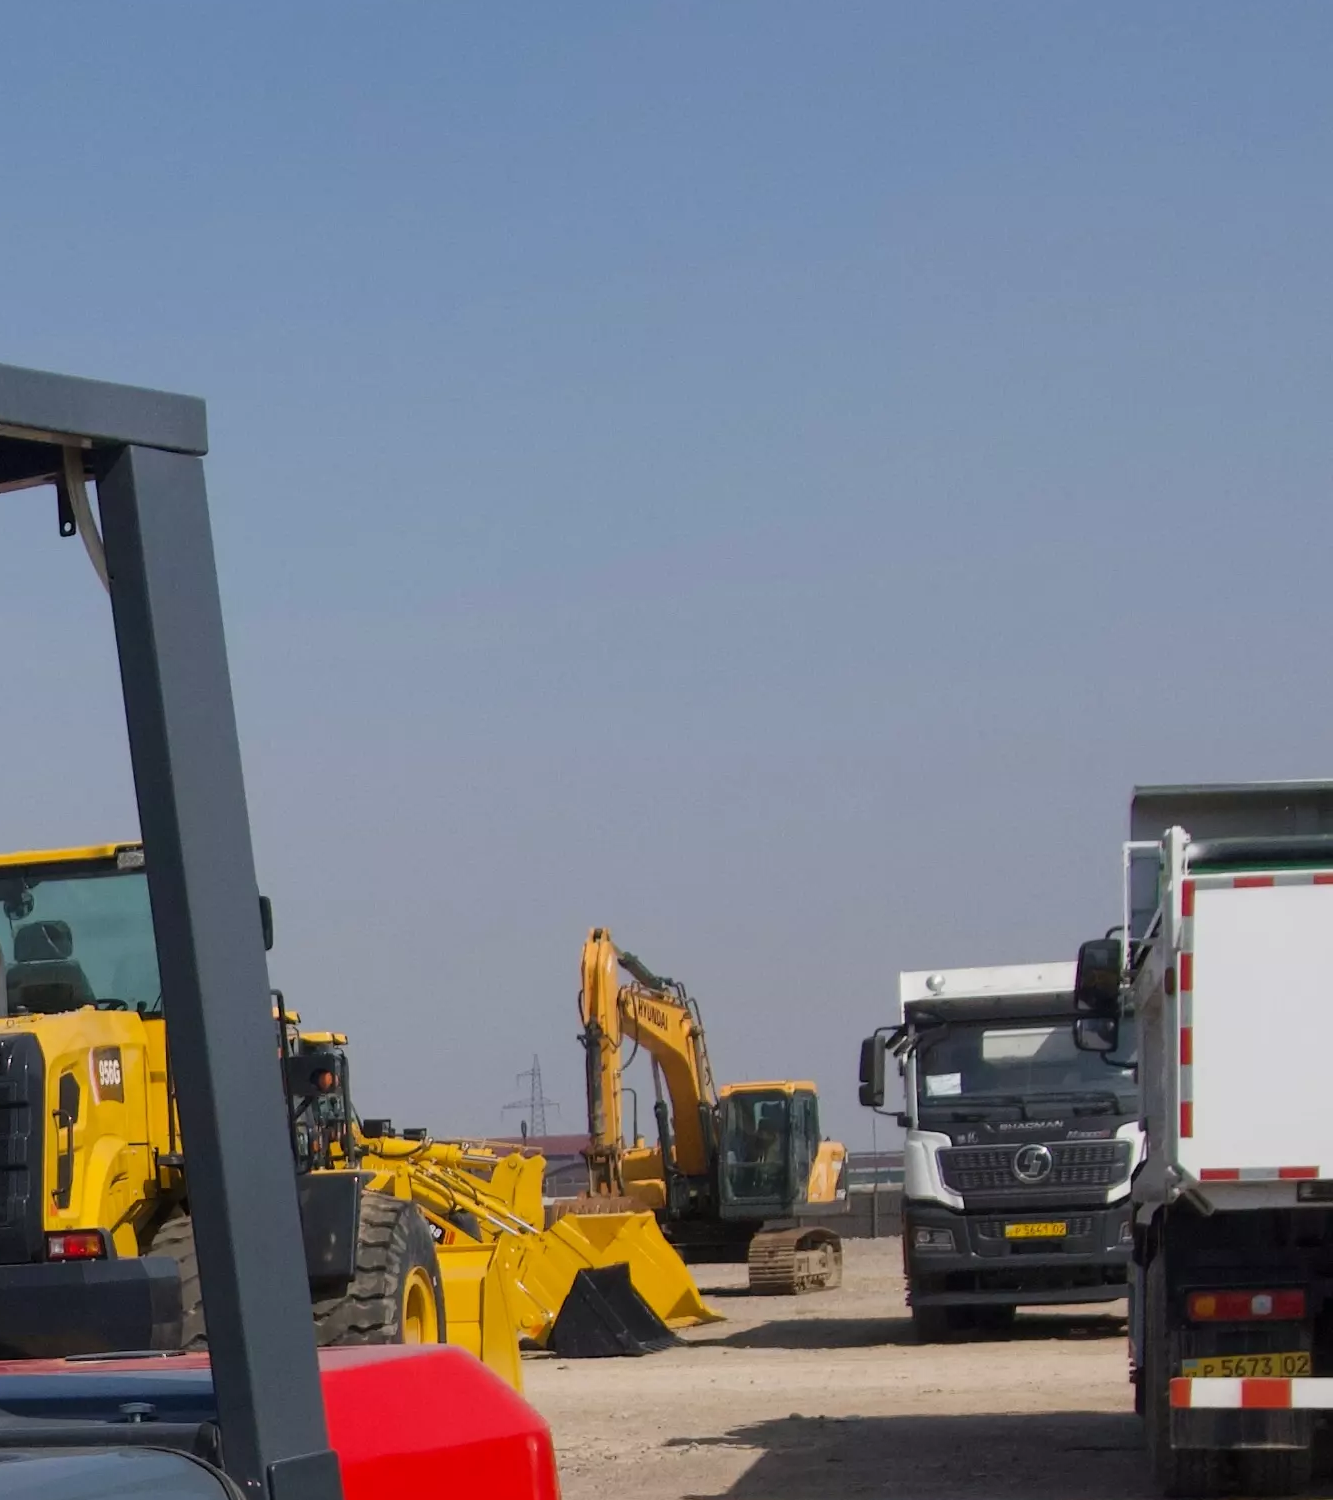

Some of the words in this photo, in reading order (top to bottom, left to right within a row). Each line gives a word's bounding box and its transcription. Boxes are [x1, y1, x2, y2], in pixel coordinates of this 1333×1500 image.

[637, 999, 668, 1031] HYUNDAI
[99, 1059, 121, 1086] 956G
[999, 1121, 1063, 1131] SHACMAN
[1221, 1356, 1273, 1377] 5673
[1283, 1355, 1310, 1375] 02
